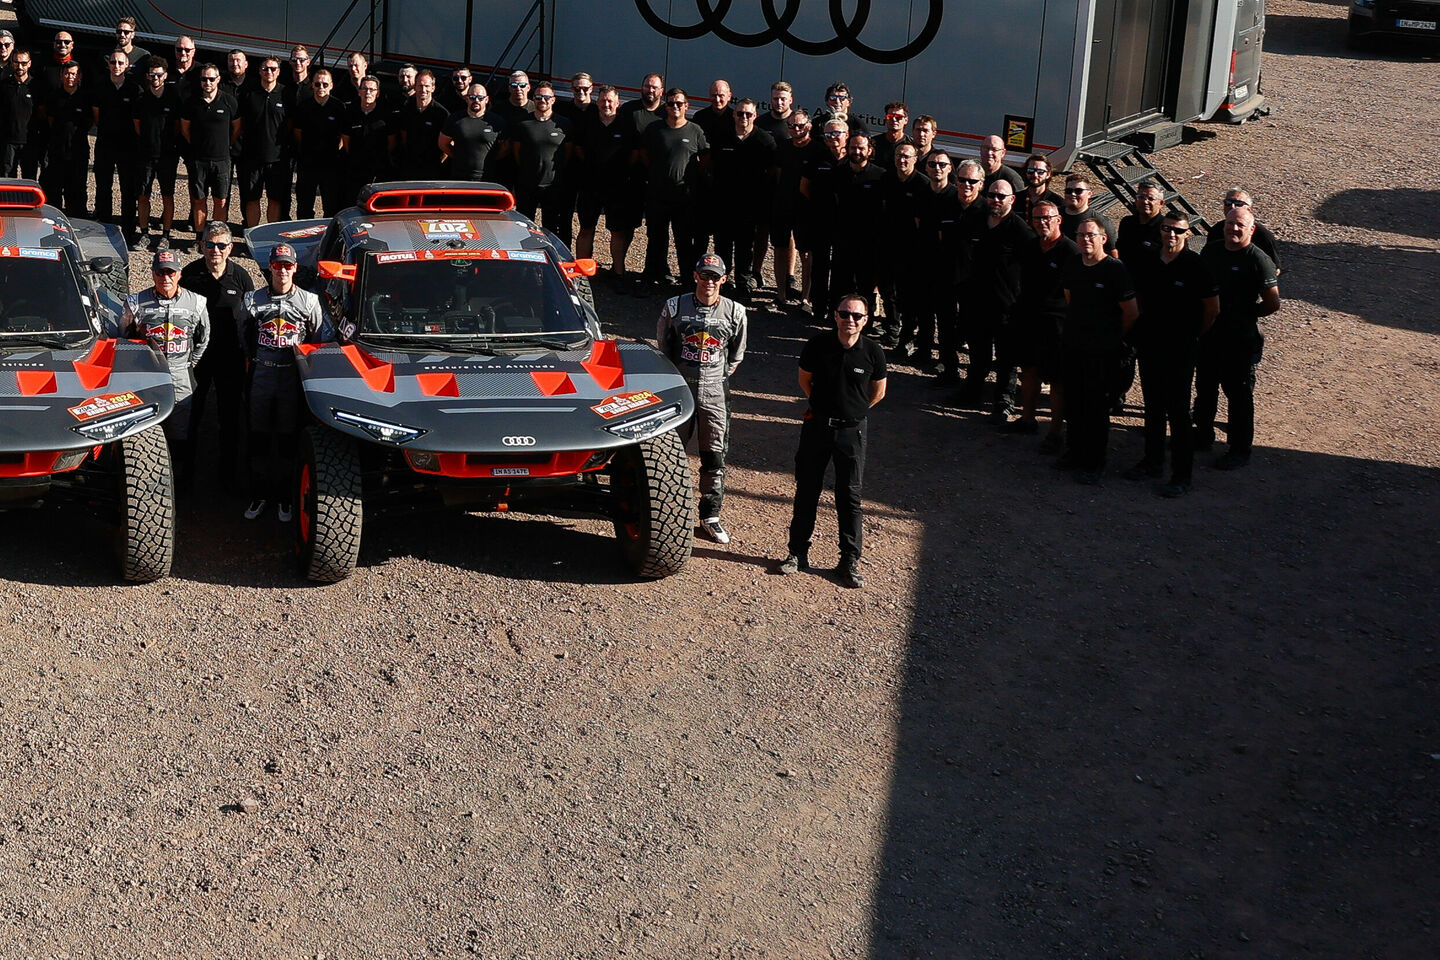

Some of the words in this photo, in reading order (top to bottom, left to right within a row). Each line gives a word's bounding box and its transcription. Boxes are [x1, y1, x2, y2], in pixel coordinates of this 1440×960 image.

[428, 223, 469, 233] 207
[21, 249, 57, 257] aramco
[379, 253, 415, 262] MOTUL
[509, 252, 546, 261] aramco
[258, 334, 278, 347] Red
[278, 334, 299, 348] Bull
[167, 341, 189, 354] Bull
[681, 348, 700, 361] Red
[701, 348, 720, 362] Bull
[109, 393, 135, 403] 2024
[628, 391, 653, 402] 2024
